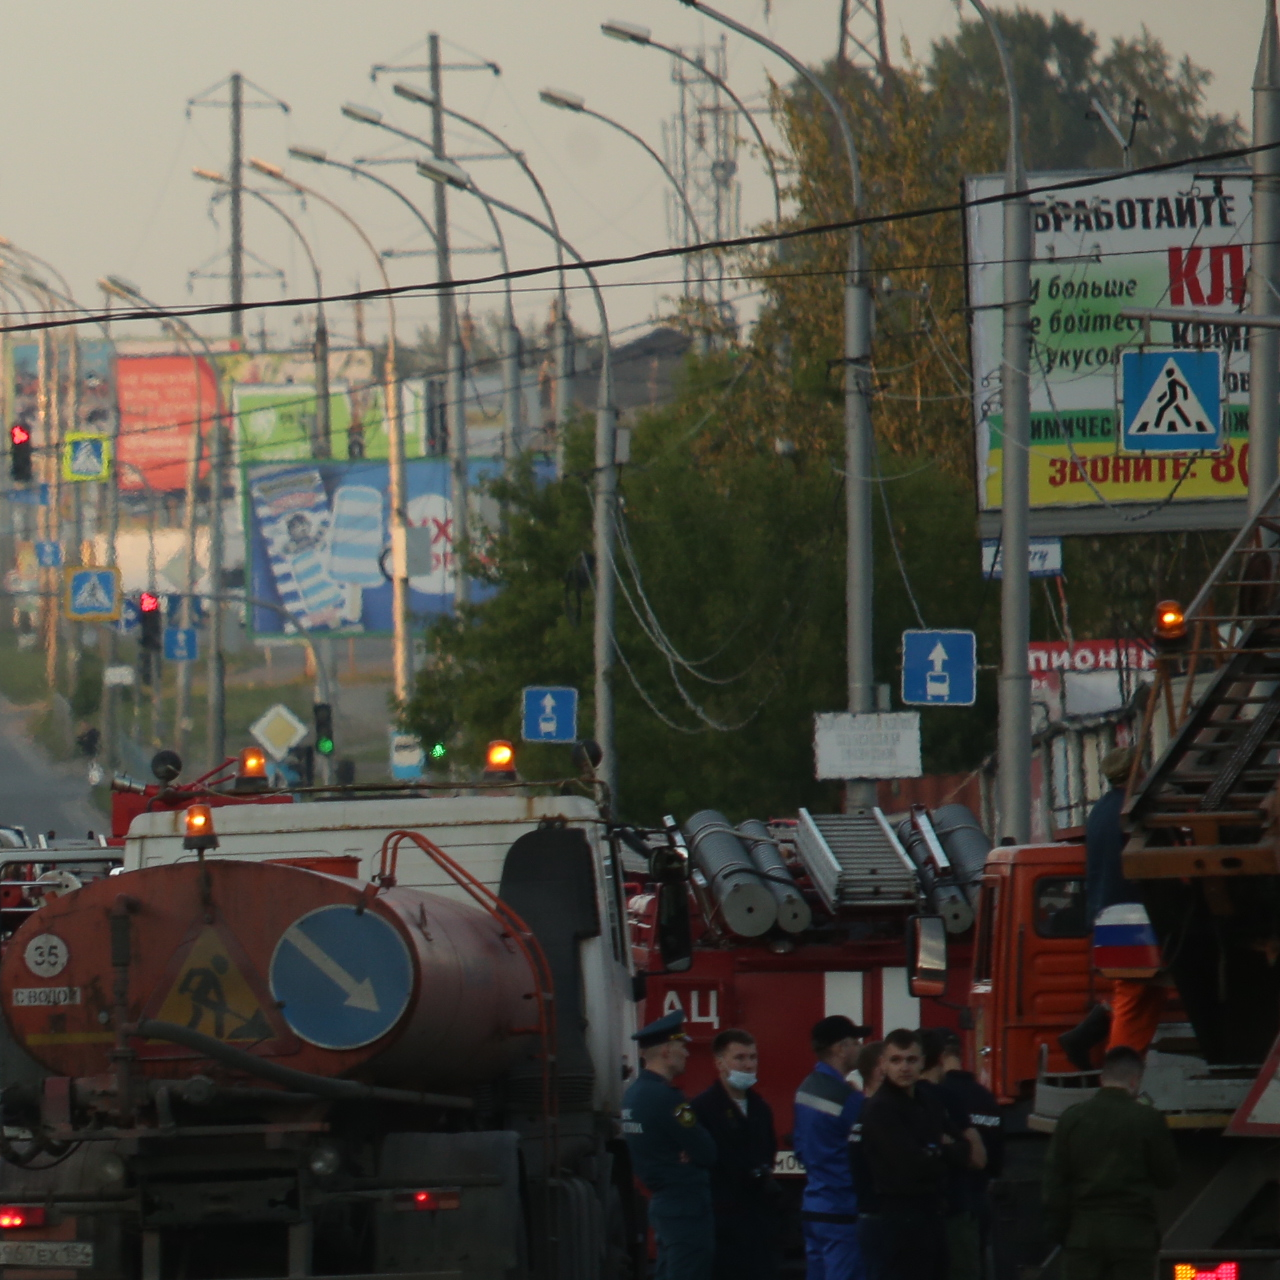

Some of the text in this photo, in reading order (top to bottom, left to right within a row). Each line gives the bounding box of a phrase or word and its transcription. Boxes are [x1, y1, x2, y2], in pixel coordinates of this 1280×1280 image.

[1030, 190, 1236, 233] БРАБОТАЙТЕ
[1048, 274, 1138, 300] больше
[1168, 244, 1246, 307] КЛ
[1030, 415, 1112, 440] ИМИЧЕС
[1210, 443, 1252, 488] 8(
[32, 944, 60, 968] 35
[662, 988, 721, 1030] АЦ
